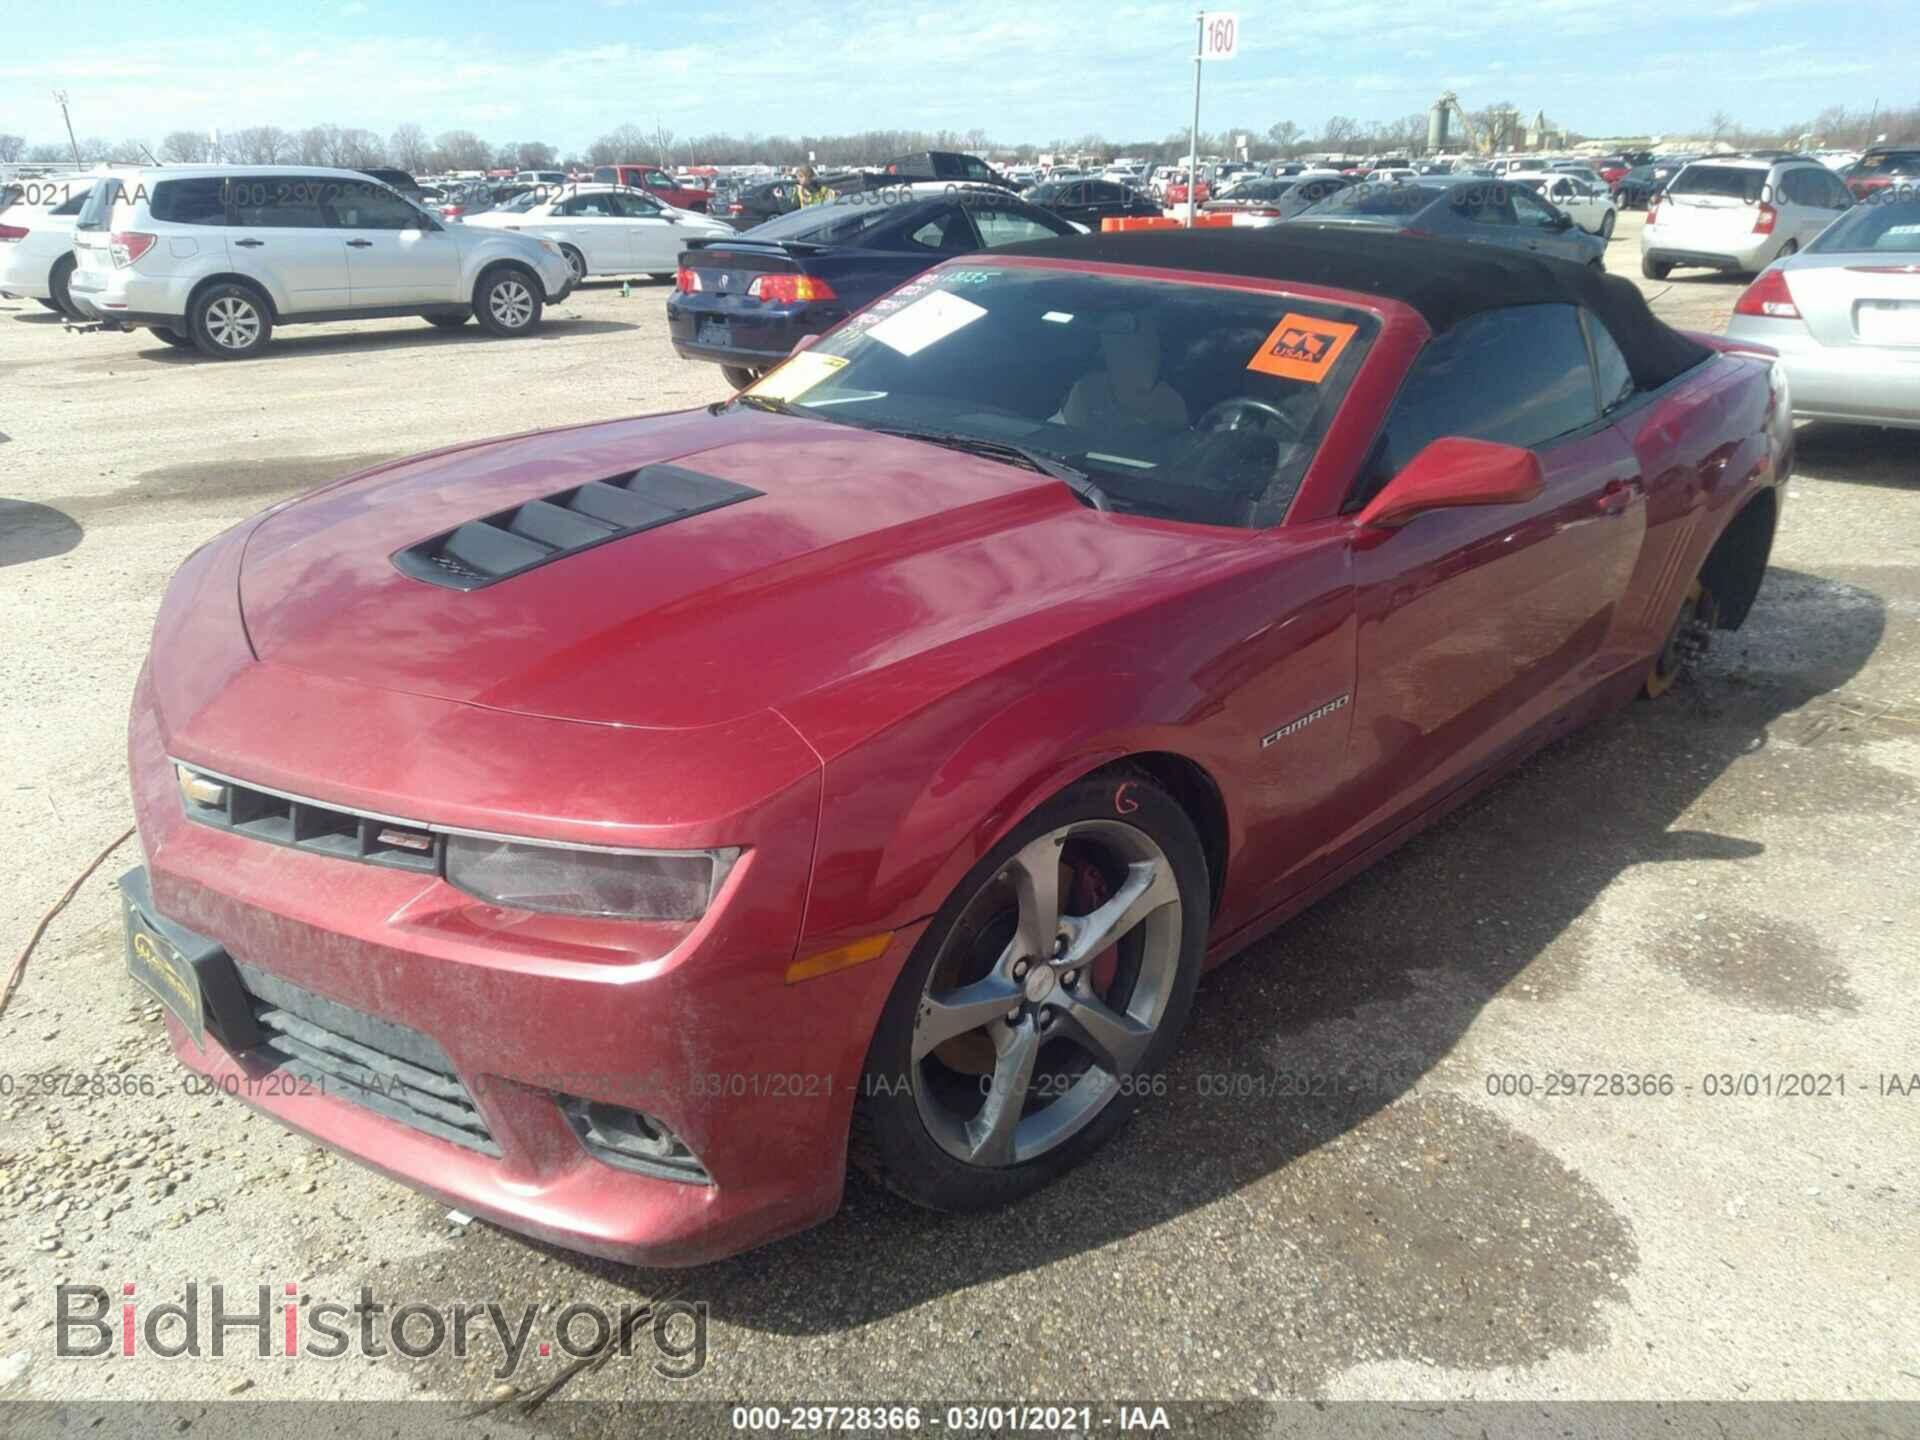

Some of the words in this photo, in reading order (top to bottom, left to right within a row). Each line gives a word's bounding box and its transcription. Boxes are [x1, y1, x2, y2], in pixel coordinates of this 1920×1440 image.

[1207, 19, 1234, 52] 160
[1272, 345, 1314, 362] USAA
[1262, 694, 1350, 749] CAMARO
